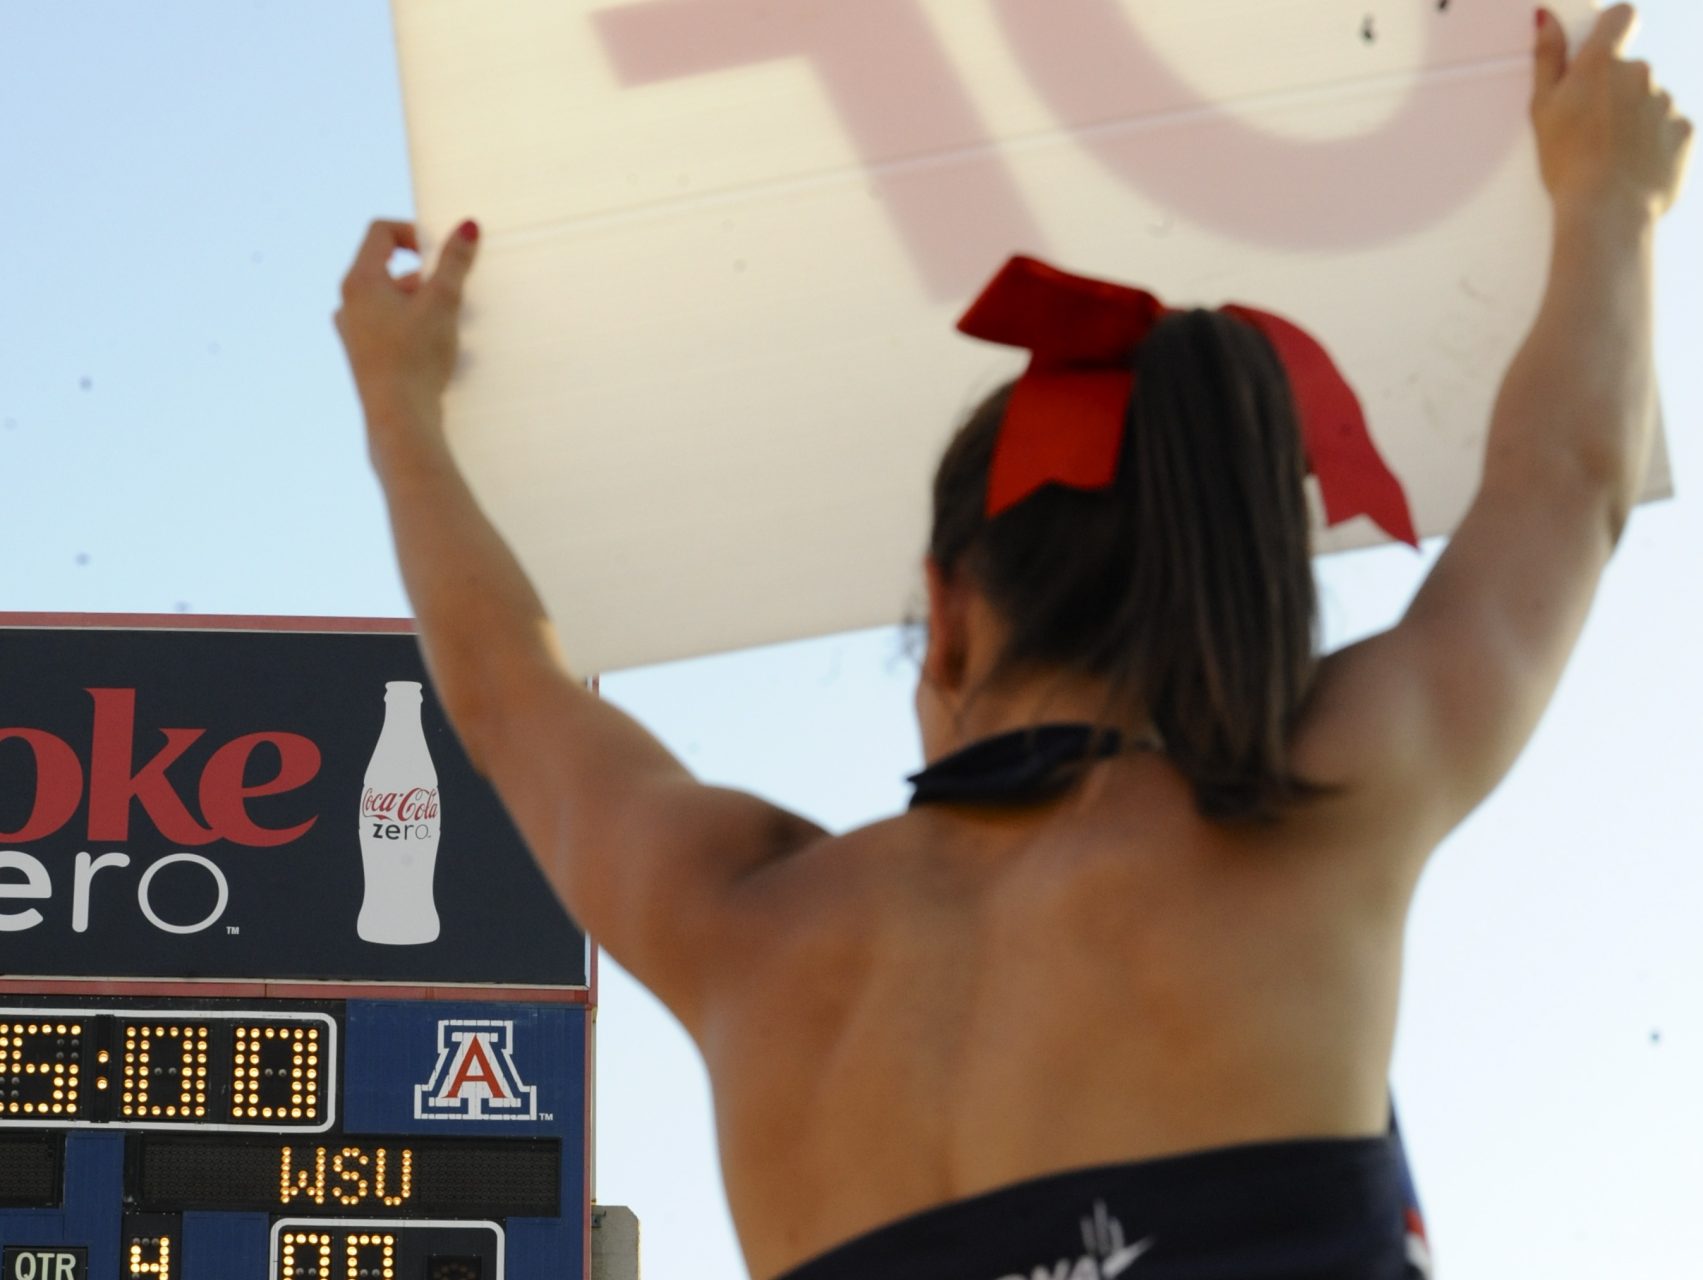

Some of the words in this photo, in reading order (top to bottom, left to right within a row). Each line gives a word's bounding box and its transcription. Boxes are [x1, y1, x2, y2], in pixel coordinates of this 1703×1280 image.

[362, 787, 439, 822] Coca-Cola
[373, 823, 429, 840] zero
[280, 1145, 413, 1206] WSU
